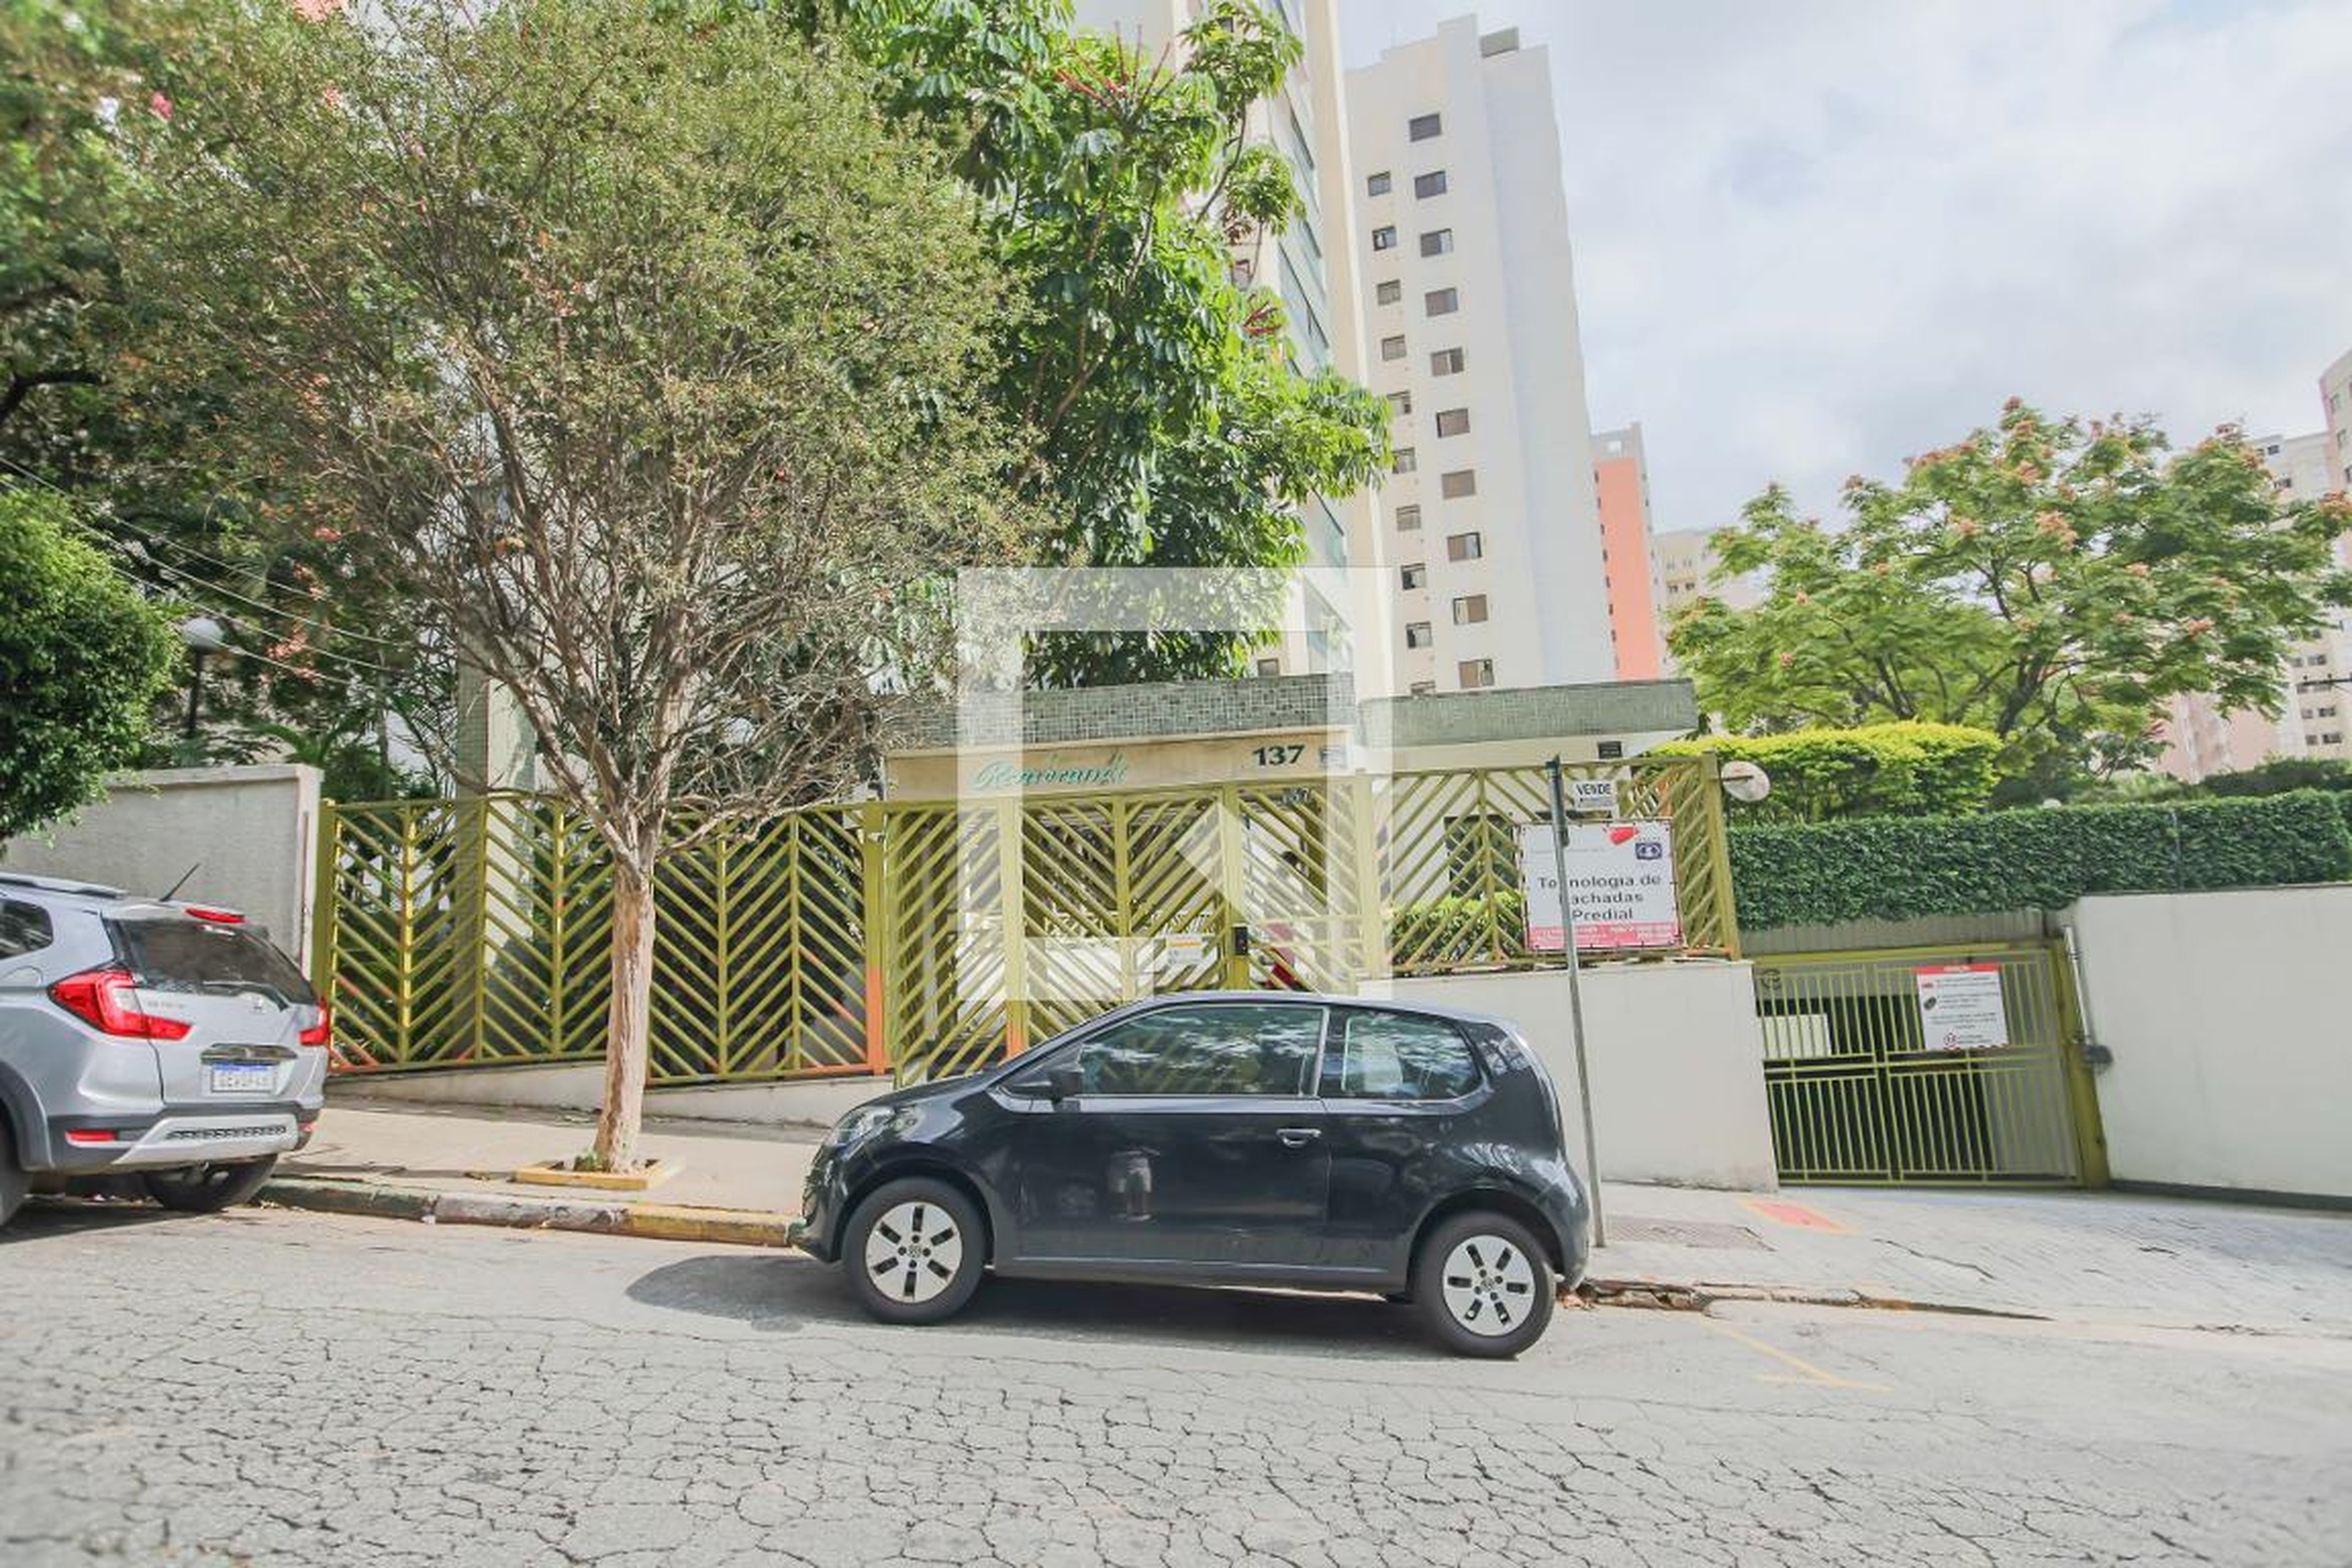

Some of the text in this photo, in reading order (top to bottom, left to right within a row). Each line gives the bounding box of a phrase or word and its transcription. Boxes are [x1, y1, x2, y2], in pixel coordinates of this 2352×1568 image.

[1252, 744, 1305, 766] 137
[1538, 876, 1634, 889] Tenologia
[1559, 892, 1643, 905] achadas
[1572, 908, 1633, 920] Predial
